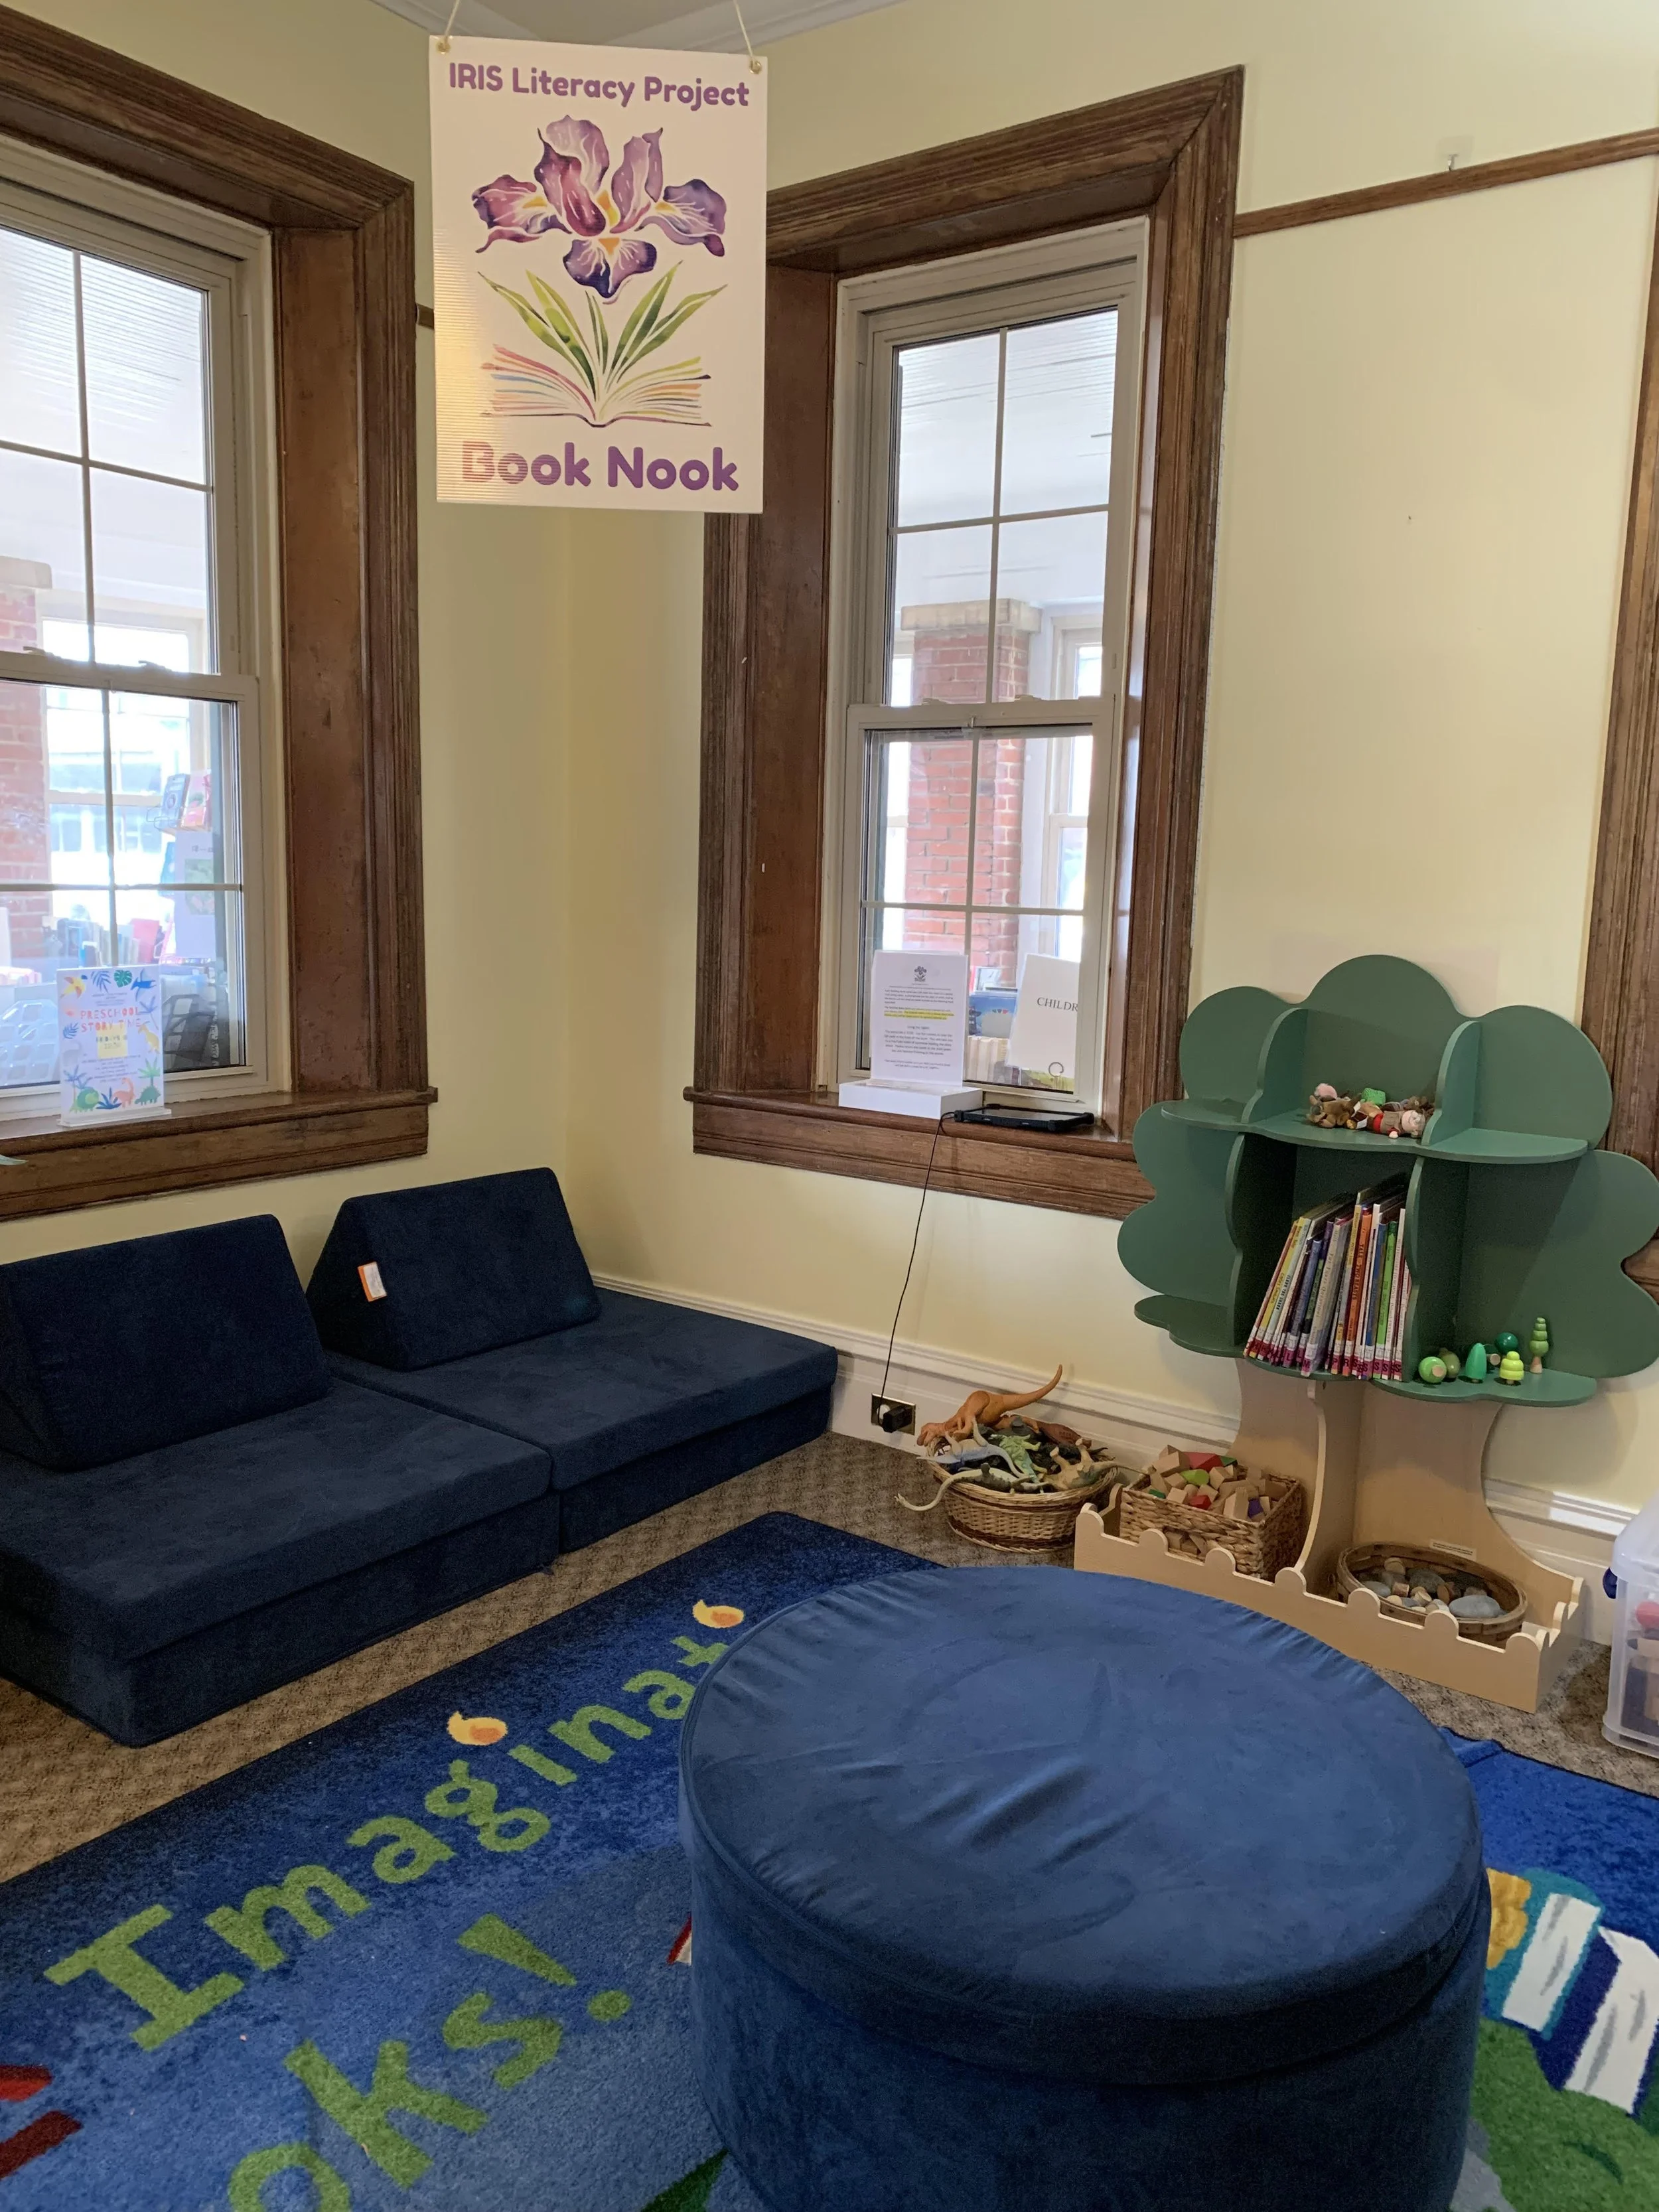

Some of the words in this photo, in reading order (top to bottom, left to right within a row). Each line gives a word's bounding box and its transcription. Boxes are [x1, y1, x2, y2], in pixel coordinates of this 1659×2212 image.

[449, 62, 503, 91] IRIS
[512, 67, 635, 108] Literacy
[644, 76, 749, 111] Project
[462, 441, 591, 487] Book
[608, 446, 739, 491] Nook
[80, 1007, 141, 1019] PRESCHOOL
[118, 1018, 141, 1029] TME
[1382, 1363, 1388, 1372] S
[44, 1600, 744, 2052] Imaginat
